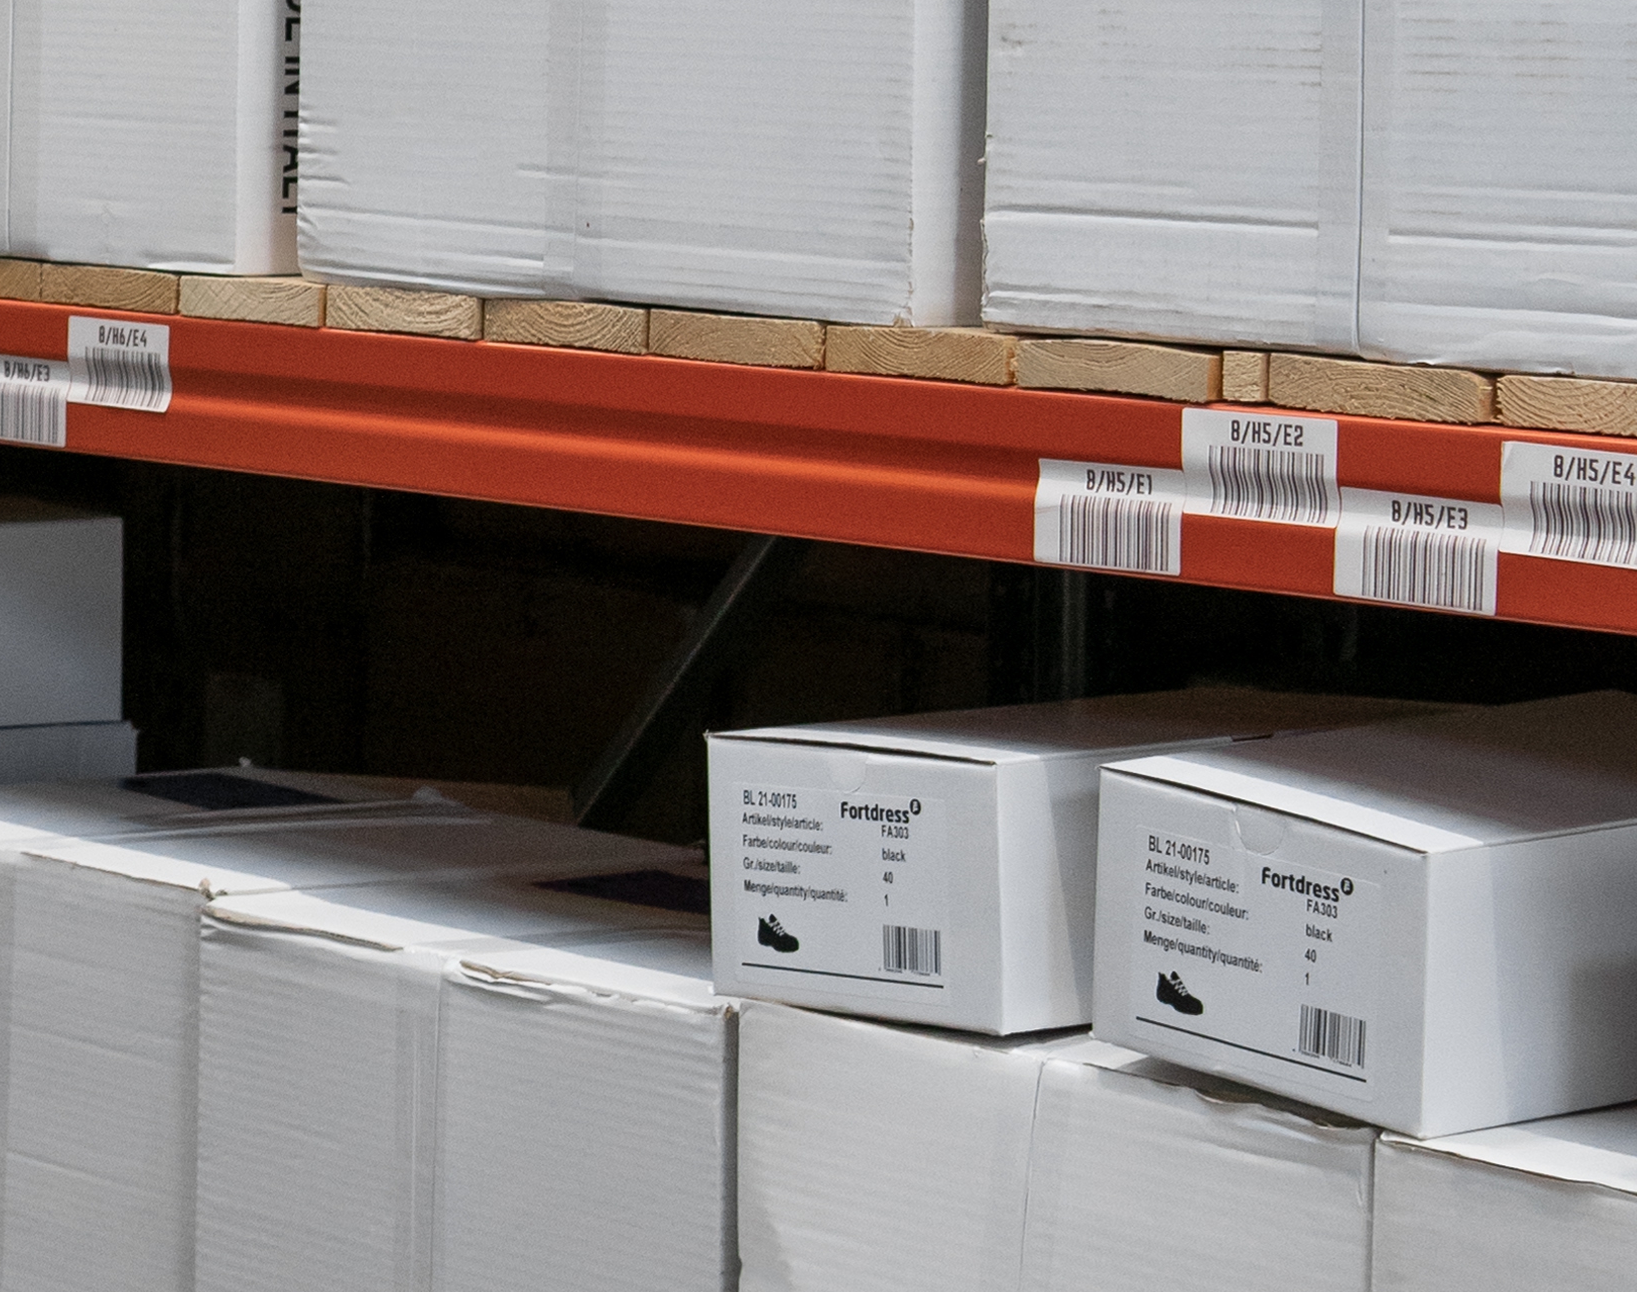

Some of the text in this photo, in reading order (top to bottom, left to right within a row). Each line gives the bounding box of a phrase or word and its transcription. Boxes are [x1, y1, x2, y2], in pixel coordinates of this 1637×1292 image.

[98, 325, 147, 347] 8/H6/E4
[4, 360, 50, 381] 8/H6/E3
[1231, 419, 1305, 447] 8/H5/E2
[1086, 469, 1153, 495] 8/H5/E1
[1554, 455, 1635, 486] 8/H5/E4
[1391, 500, 1468, 529] 8/H5/E3
[743, 790, 797, 809] BL 21-00175
[841, 801, 910, 823] Fortdress
[742, 812, 909, 840] Artikel/style/article: FA303
[743, 834, 906, 863] Farbe/colour/couleur: black
[1148, 835, 1210, 865] BL 21-00175
[743, 857, 894, 884] Gr./size/taille: 40
[1261, 867, 1340, 902] Fortdress
[744, 879, 889, 907] Menge/quantity/quantité: 1
[1145, 859, 1338, 919] Artikel/style/article: FA303
[1145, 883, 1333, 943] Farbe/colour/couleur: black
[1144, 907, 1317, 963] Gr./size/taille: 40
[1143, 929, 1310, 986] Menge/quantity/quantité: 1
